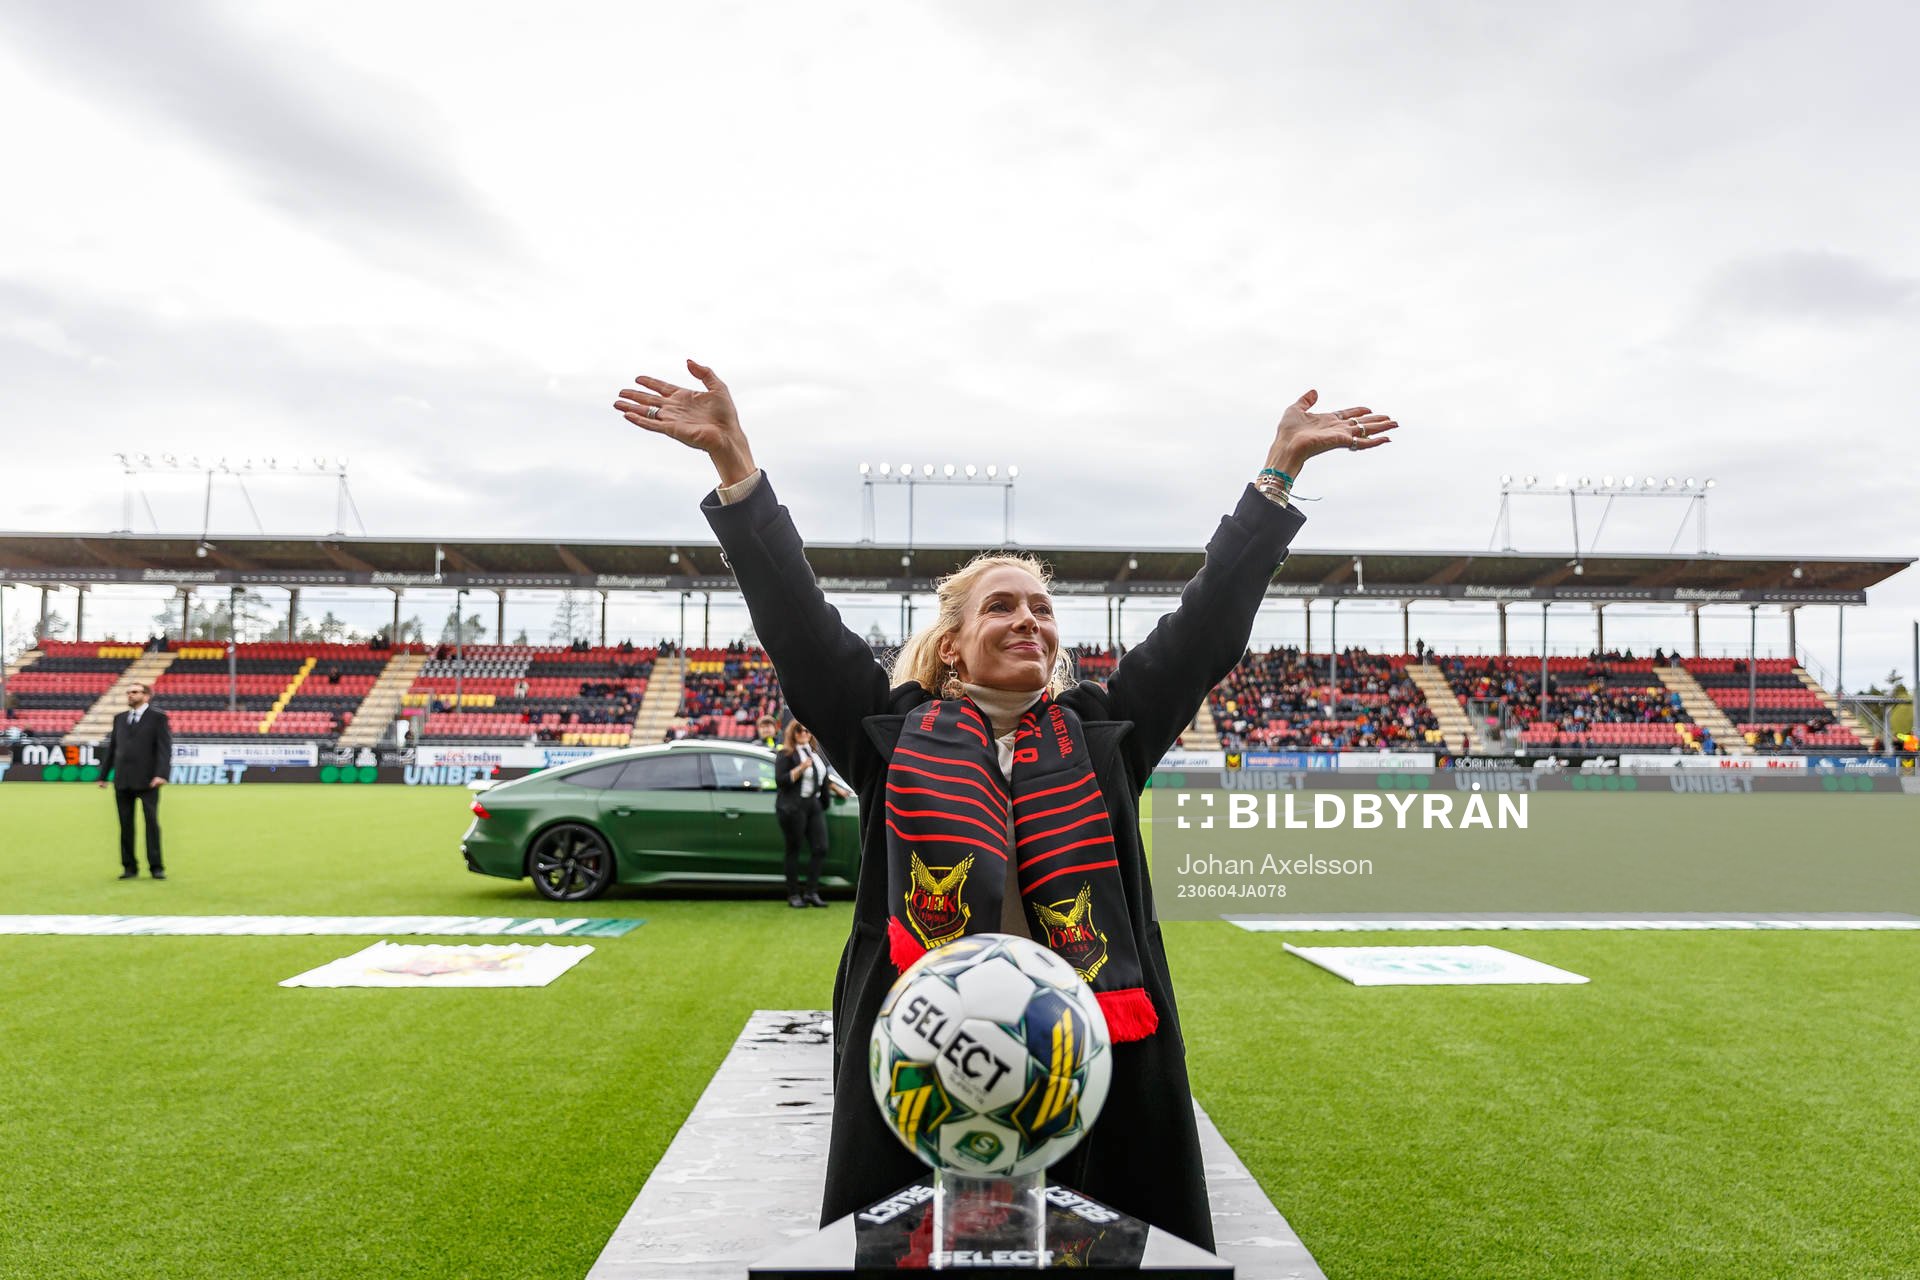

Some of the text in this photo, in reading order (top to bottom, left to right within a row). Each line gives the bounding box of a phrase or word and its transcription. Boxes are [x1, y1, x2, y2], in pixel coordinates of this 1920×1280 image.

[1052, 720, 1068, 735] DET
[169, 765, 248, 784] NIBET
[403, 764, 492, 785] UNIBET
[1220, 770, 1306, 790] UNIBET
[1454, 772, 1539, 792] UNIBET
[1670, 775, 1753, 793] UNIBET
[912, 889, 957, 913] ÖFK
[1051, 923, 1095, 949] ÖFK
[902, 995, 1012, 1093] SELECT
[859, 1185, 947, 1225] SELECT
[1028, 1186, 1120, 1223] SELECT
[928, 1250, 1055, 1267] SELECT
